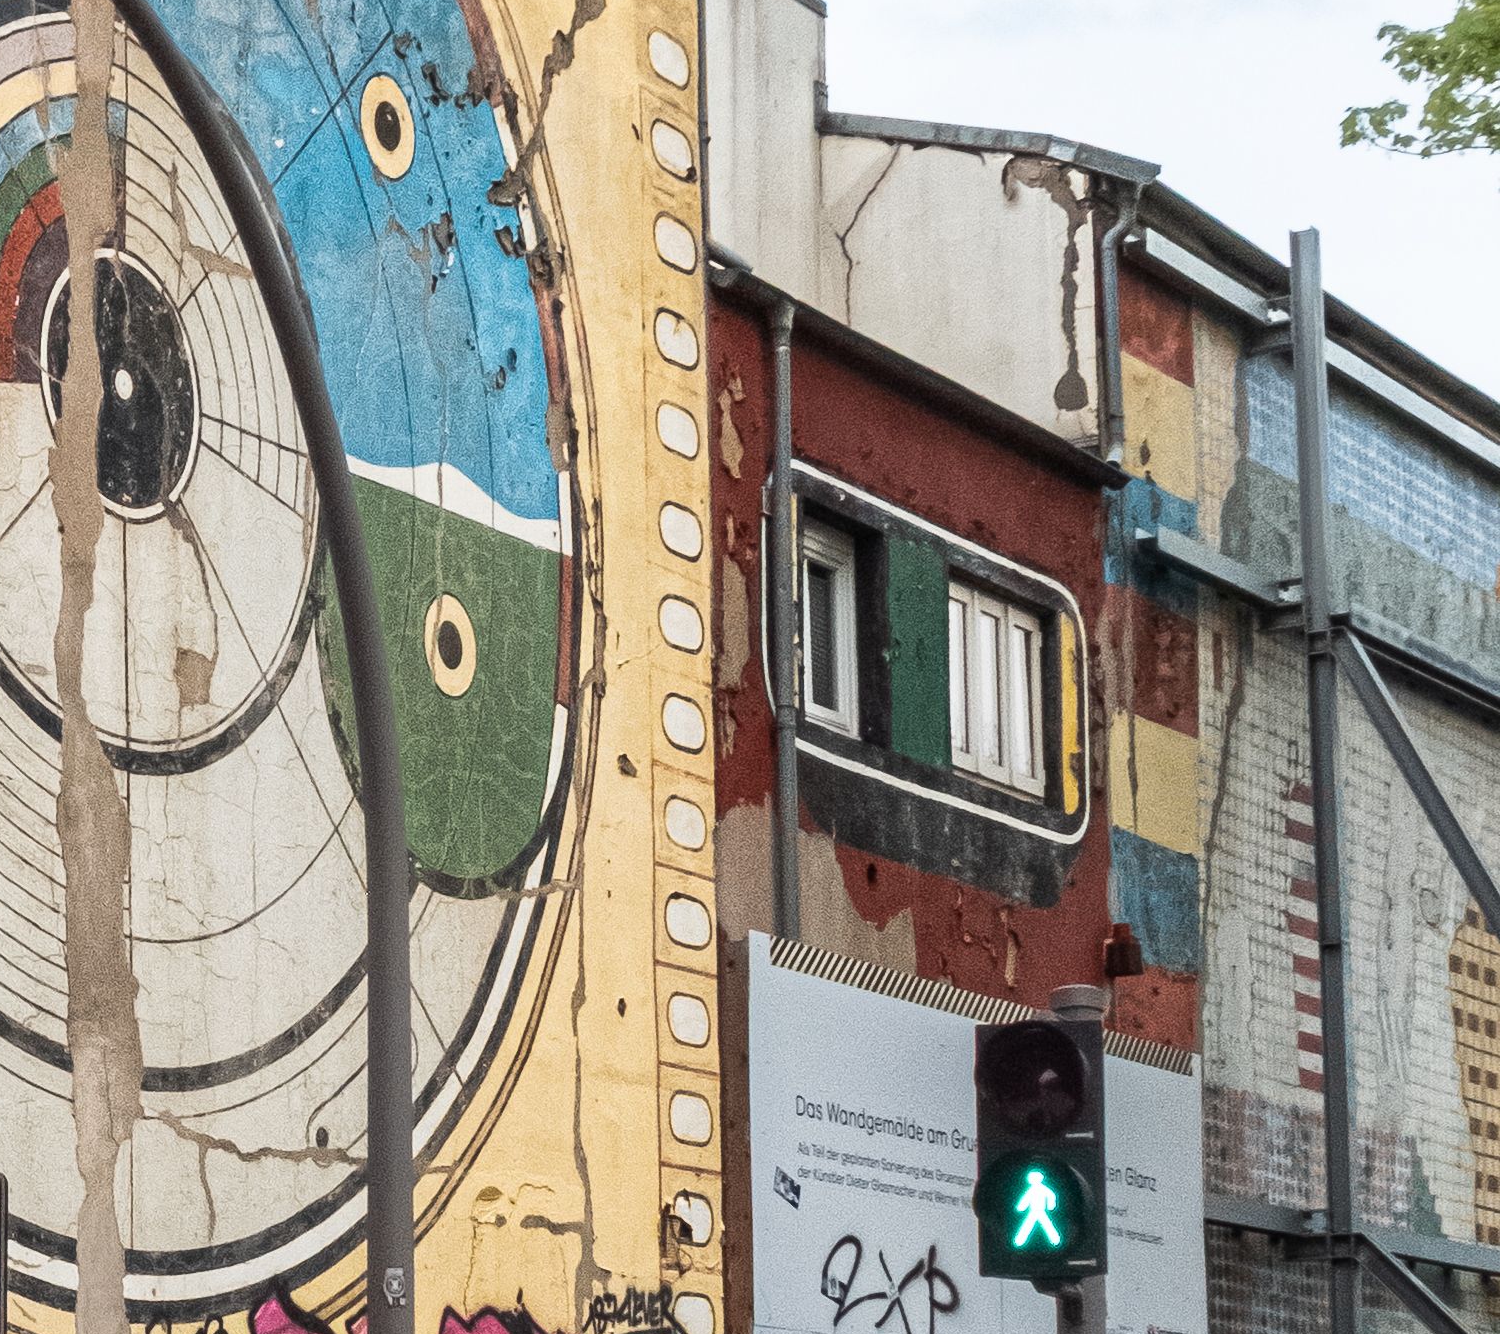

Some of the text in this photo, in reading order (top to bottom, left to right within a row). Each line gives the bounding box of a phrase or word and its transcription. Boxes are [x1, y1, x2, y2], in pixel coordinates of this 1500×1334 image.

[796, 1095, 823, 1120] Das
[826, 1102, 924, 1142] Wandgemälde
[927, 1127, 949, 1147] am
